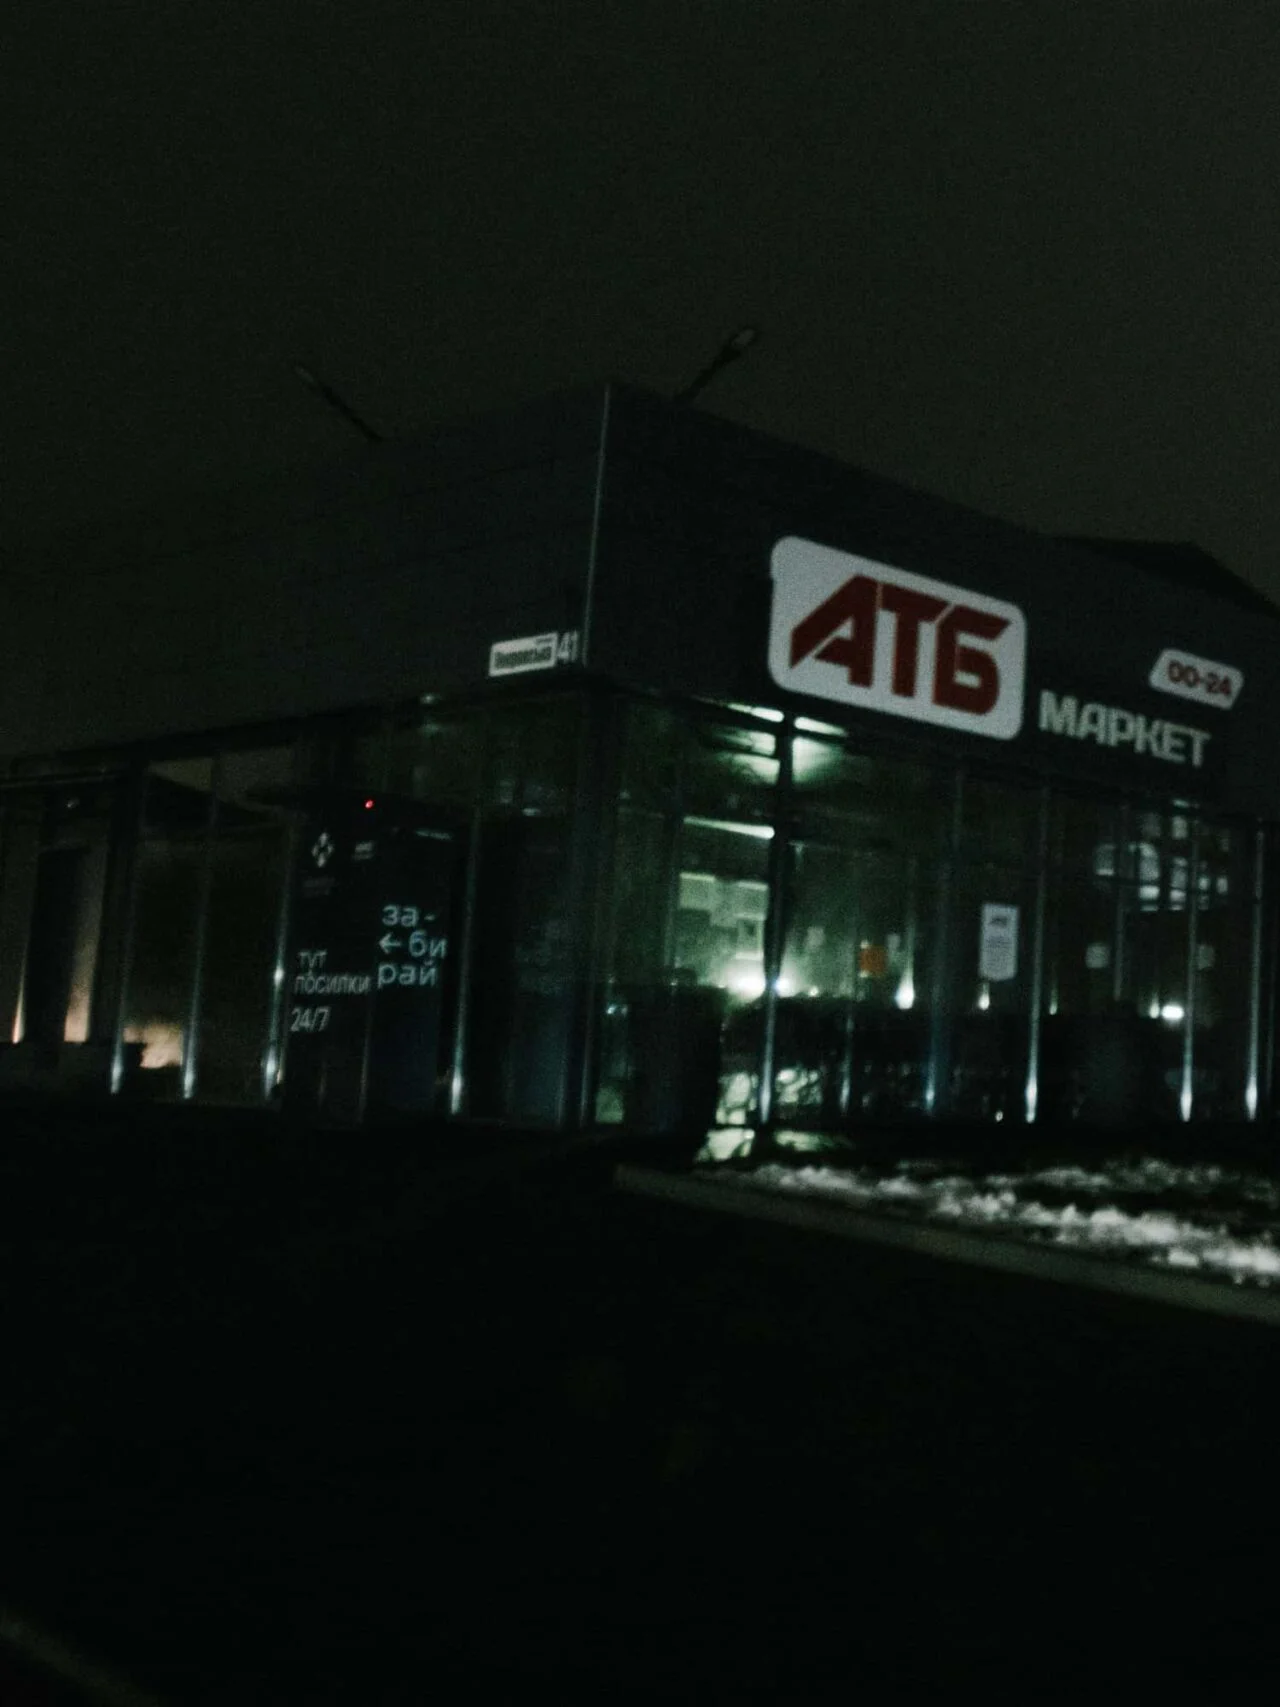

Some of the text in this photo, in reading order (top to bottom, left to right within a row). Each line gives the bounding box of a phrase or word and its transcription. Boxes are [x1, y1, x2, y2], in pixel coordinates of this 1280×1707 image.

[791, 575, 1010, 715] АТБ
[1168, 660, 1232, 696] 00-24
[1039, 689, 1212, 768] МАРКЕТ
[408, 929, 449, 959] би
[377, 960, 439, 990] рай
[290, 1005, 332, 1033] 24/7
